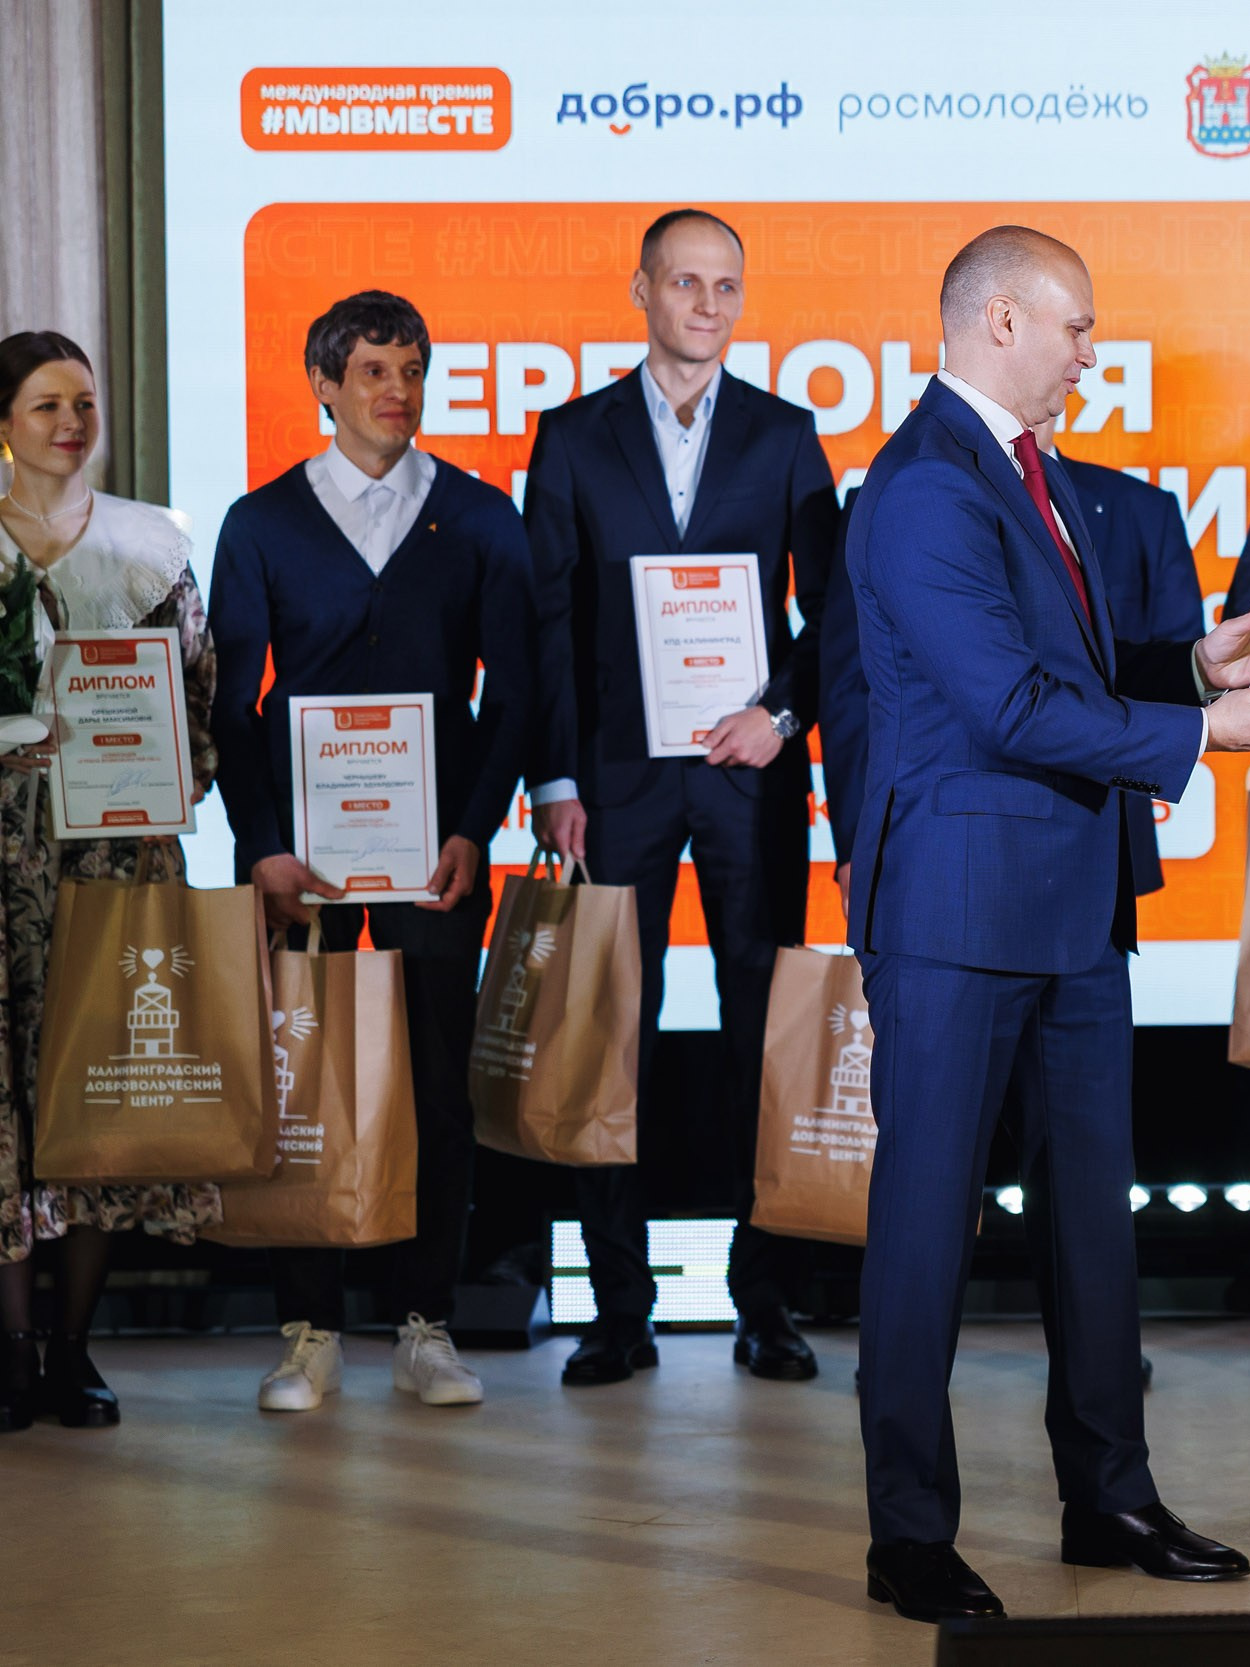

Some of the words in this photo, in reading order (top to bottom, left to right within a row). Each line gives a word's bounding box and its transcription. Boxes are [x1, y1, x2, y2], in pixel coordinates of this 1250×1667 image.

[261, 84, 416, 105] международная
[420, 84, 494, 105] премия
[557, 82, 803, 128] добро.рф
[838, 83, 1149, 133] росмолодёжь
[261, 106, 494, 135] #МЫВМЕСТЕ
[661, 599, 737, 617] ДИПЛОМ
[68, 675, 155, 693] ДИПЛОМ
[319, 741, 408, 758] ДИПЛОМ
[87, 1062, 221, 1076] КАЛИНИНГРАДСКИЙ
[84, 1077, 222, 1092] ДОБРОВОЛЬЧЕСКИЙ
[130, 1095, 174, 1107] ЦЕНТР
